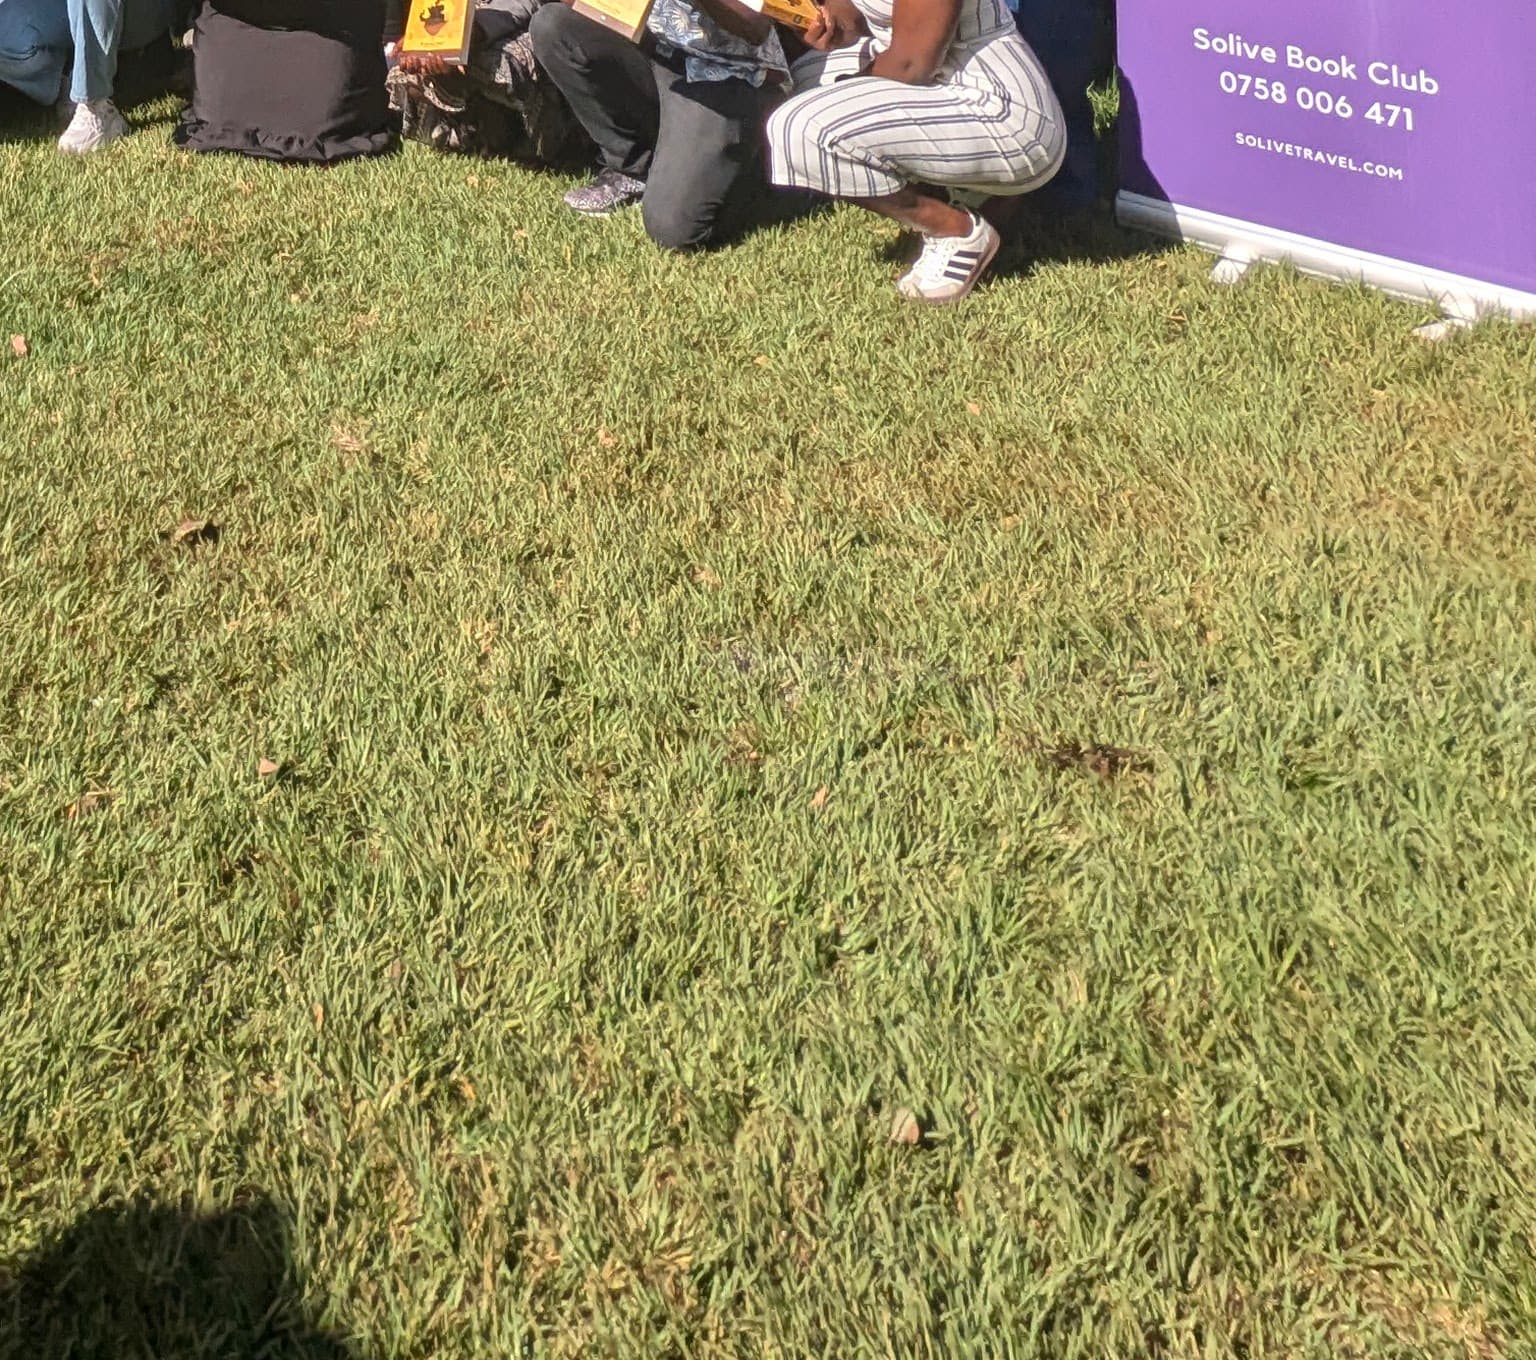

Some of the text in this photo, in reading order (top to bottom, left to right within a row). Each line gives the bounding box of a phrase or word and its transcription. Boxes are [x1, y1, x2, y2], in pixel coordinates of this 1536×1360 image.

[1193, 28, 1439, 95] Solive Book Club
[1219, 71, 1413, 131] 0758 006 471
[1235, 132, 1403, 181] SOLIVETRAVEL.COM
